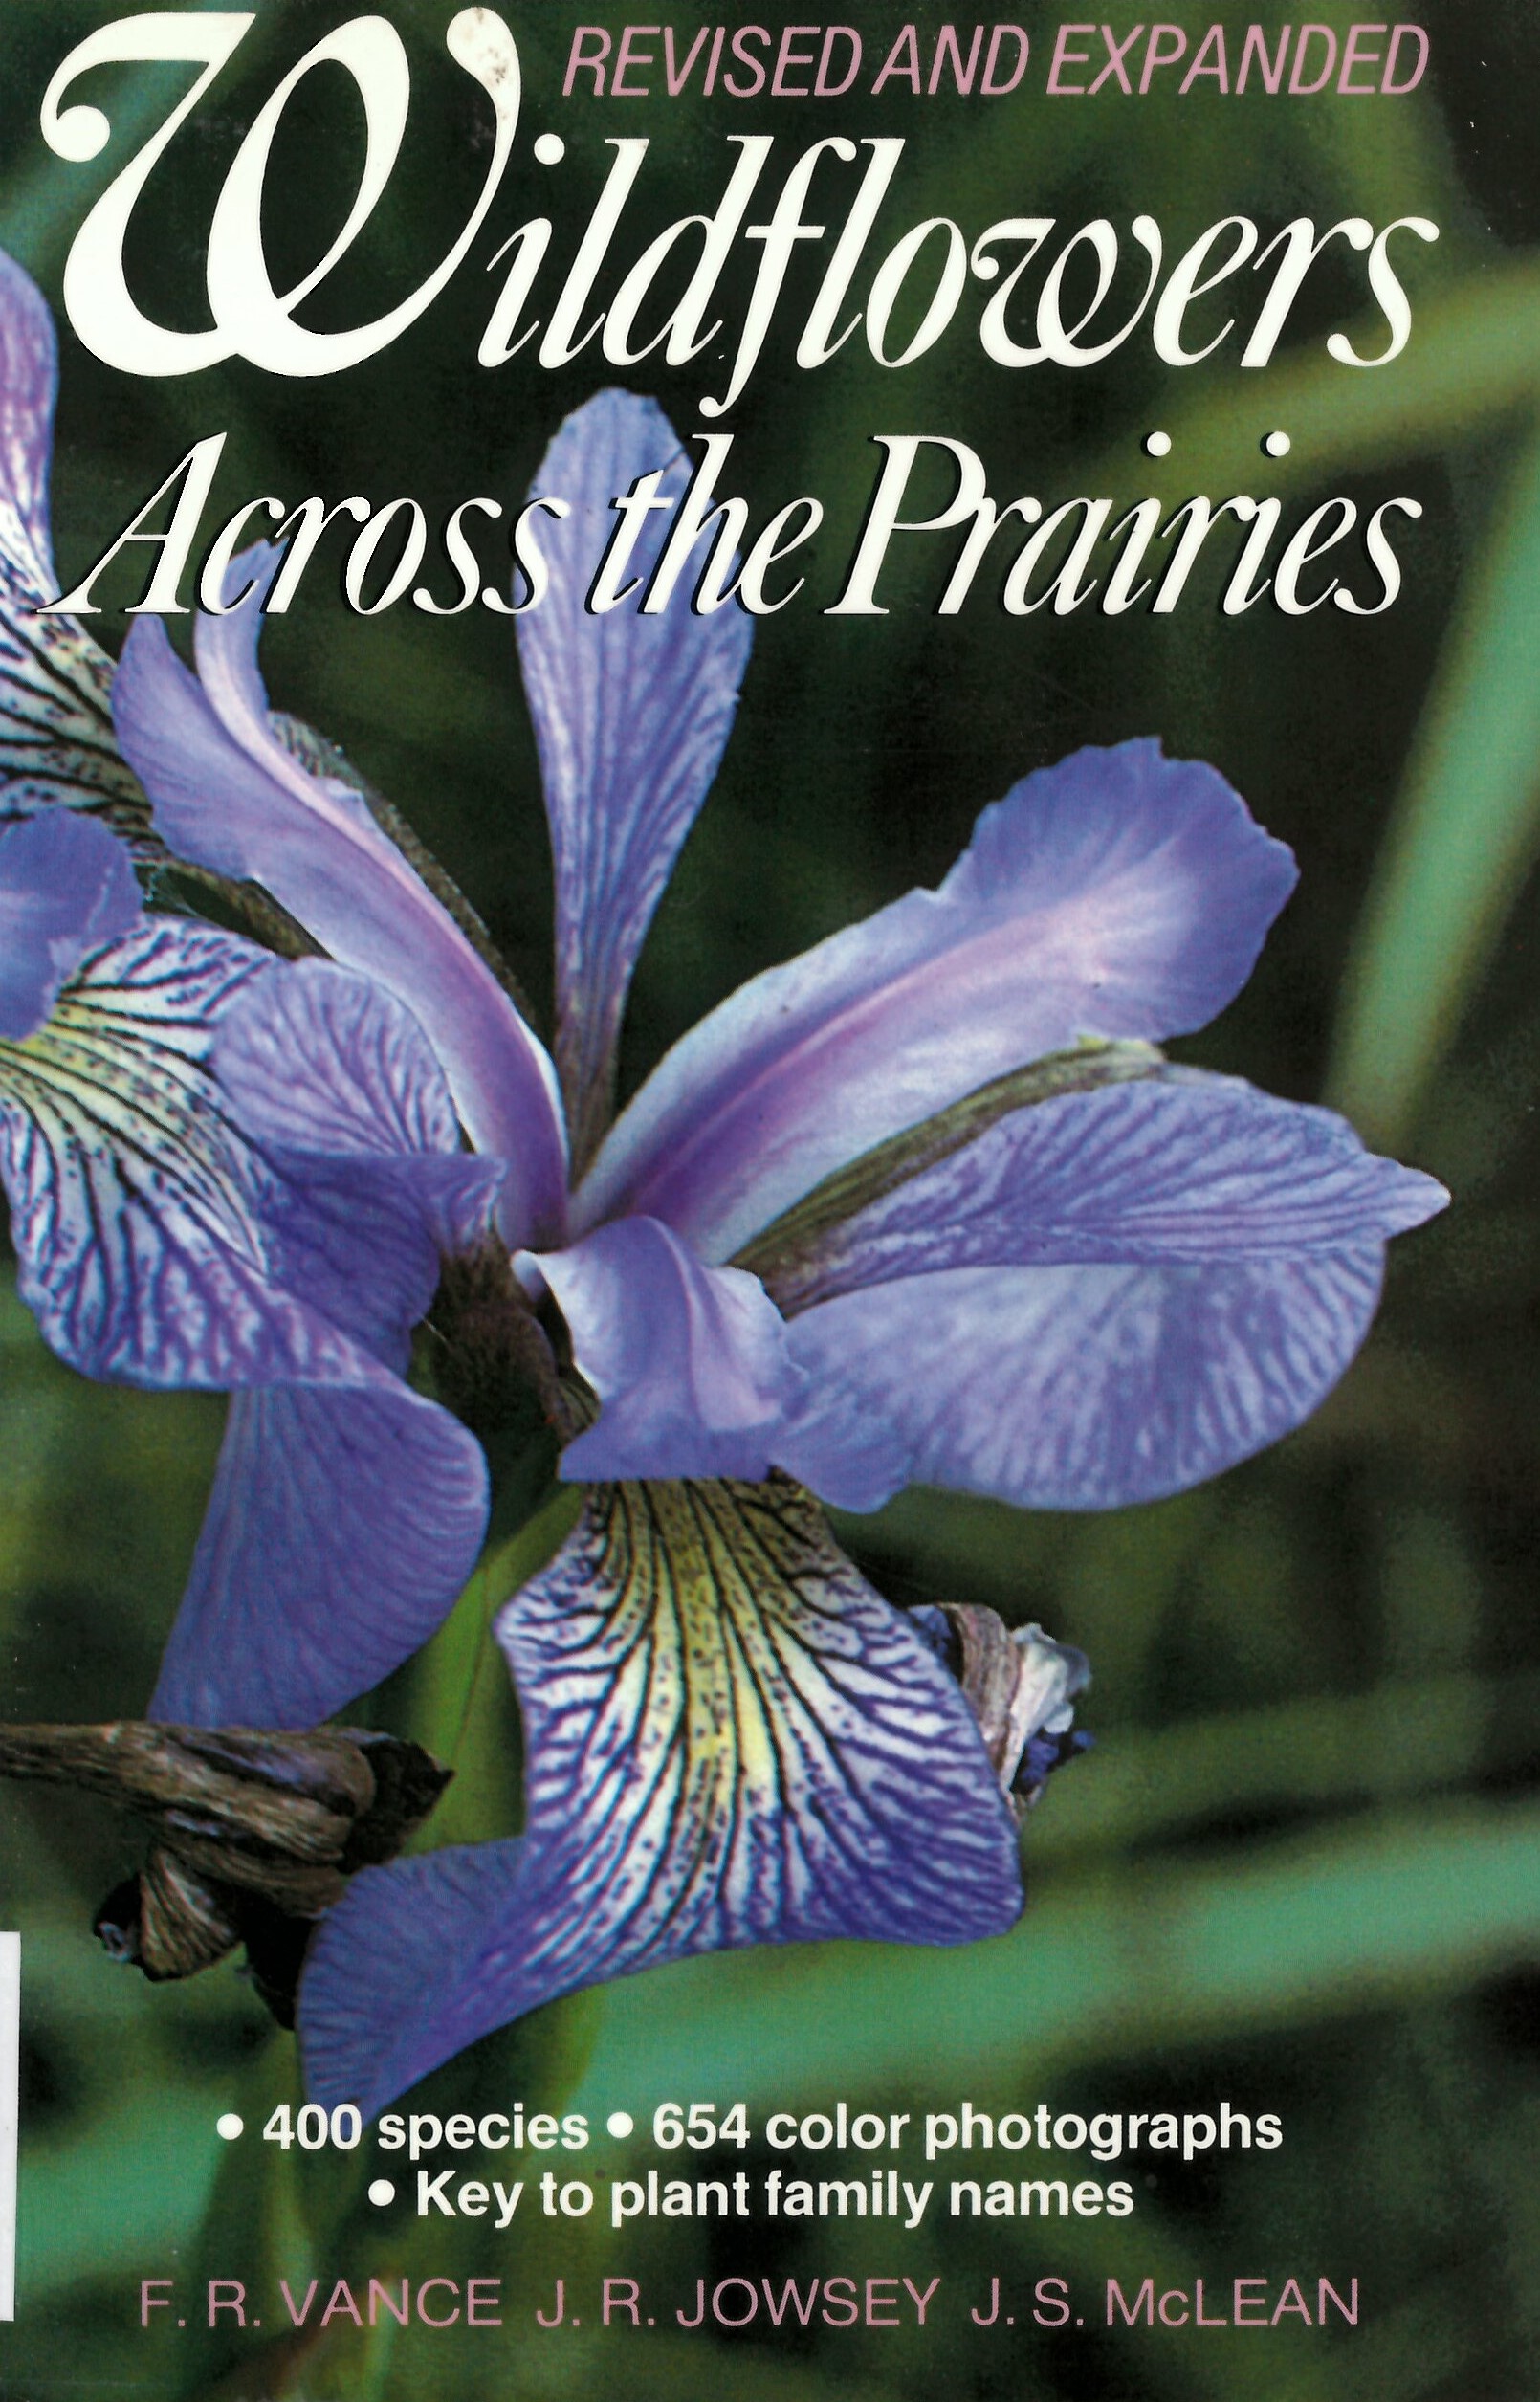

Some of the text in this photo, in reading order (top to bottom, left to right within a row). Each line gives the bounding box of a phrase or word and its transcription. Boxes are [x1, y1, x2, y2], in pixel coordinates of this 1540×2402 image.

[562, 24, 1431, 97] REVISED AND EXPANDED
[40, 7, 1441, 418] Wildflowers
[36, 431, 1423, 616] Across the Prairies
[263, 2102, 1283, 2161] 400 species 654 color photographs
[417, 2170, 1133, 2229] Key to plant family names
[140, 2278, 1359, 2326] F. R. VANCE J. R. JOWSEY J. S. McLEAN
